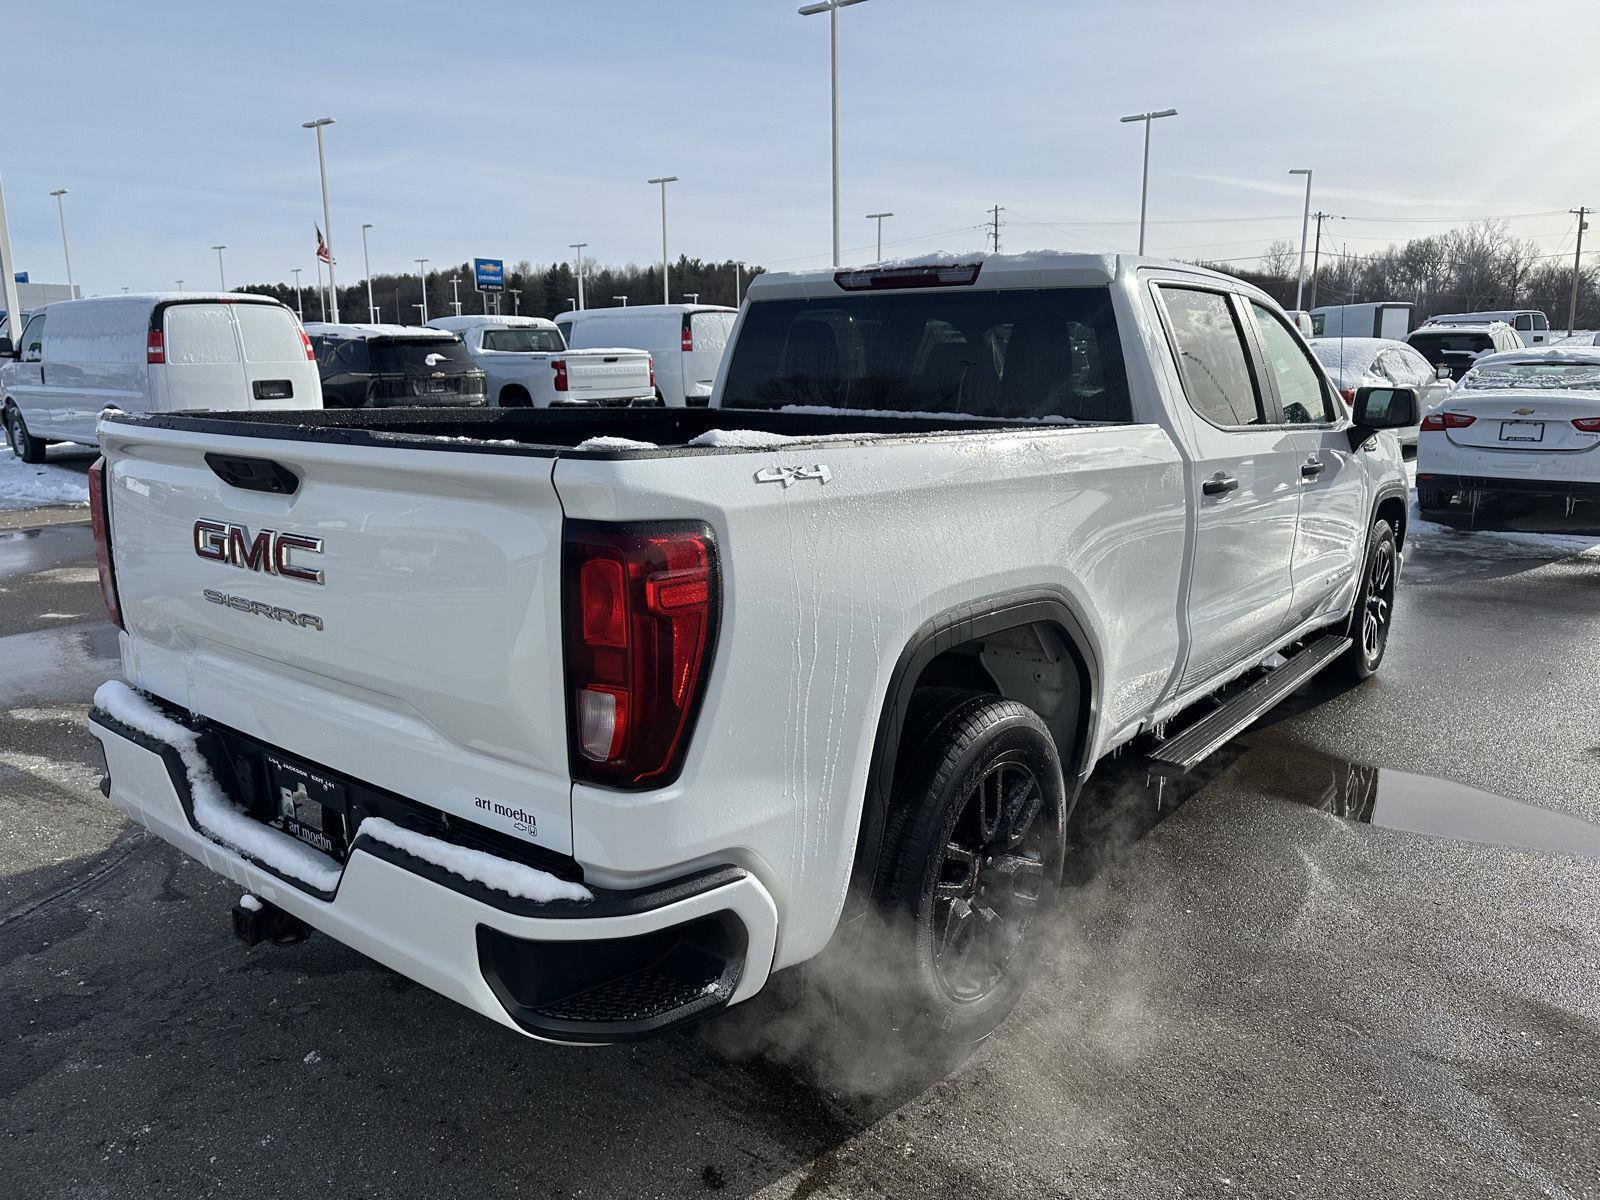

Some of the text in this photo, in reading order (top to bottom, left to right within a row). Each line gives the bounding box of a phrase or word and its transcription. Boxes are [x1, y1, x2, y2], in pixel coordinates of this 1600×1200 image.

[193, 517, 325, 585] GMC
[203, 588, 323, 631] SIERRA
[283, 763, 308, 777] JACKSON
[311, 774, 323, 784] EXIT
[475, 796, 536, 826] art moehn
[288, 820, 332, 851] art moehn
